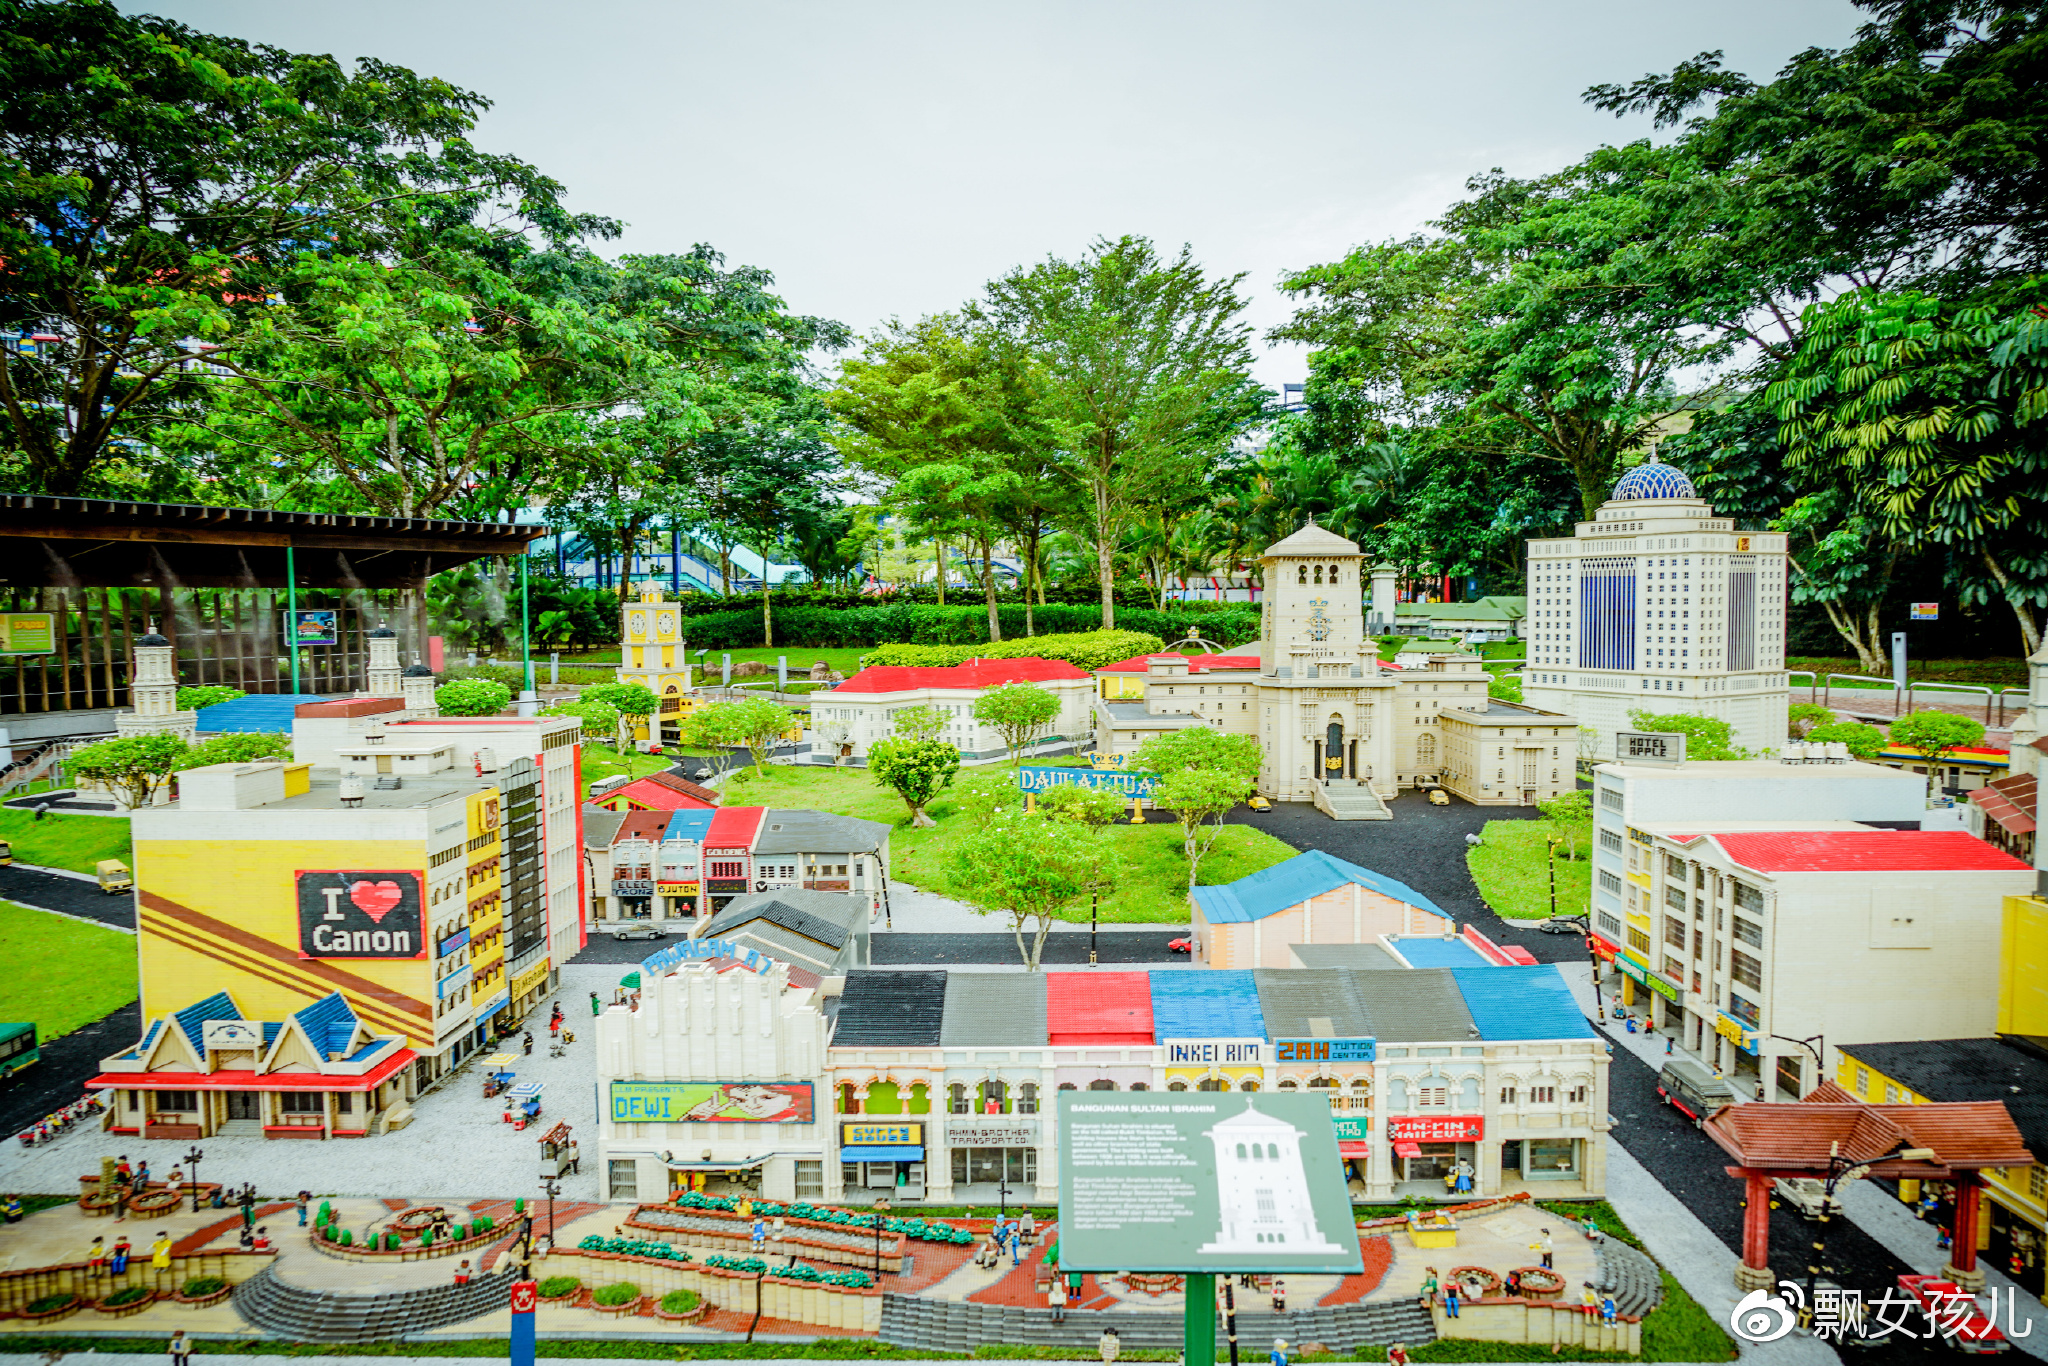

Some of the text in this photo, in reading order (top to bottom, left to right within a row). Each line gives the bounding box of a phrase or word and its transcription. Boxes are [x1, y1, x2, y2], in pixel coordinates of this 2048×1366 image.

[1630, 738, 1666, 748] HOTEL
[1630, 747, 1667, 757] APPLE
[321, 888, 345, 921] I
[312, 924, 411, 952] Canon
[640, 938, 737, 977] PAWAGAM
[1333, 1042, 1373, 1050] TUITION
[1170, 1044, 1260, 1062] INKEI RIM
[615, 1096, 672, 1118] DEWI
[1071, 1104, 1215, 1113] BANGUNAN SULTAN IBRAHIM
[853, 1134, 909, 1142] HOUSE
[951, 1137, 1013, 1145] TRANSPORT
